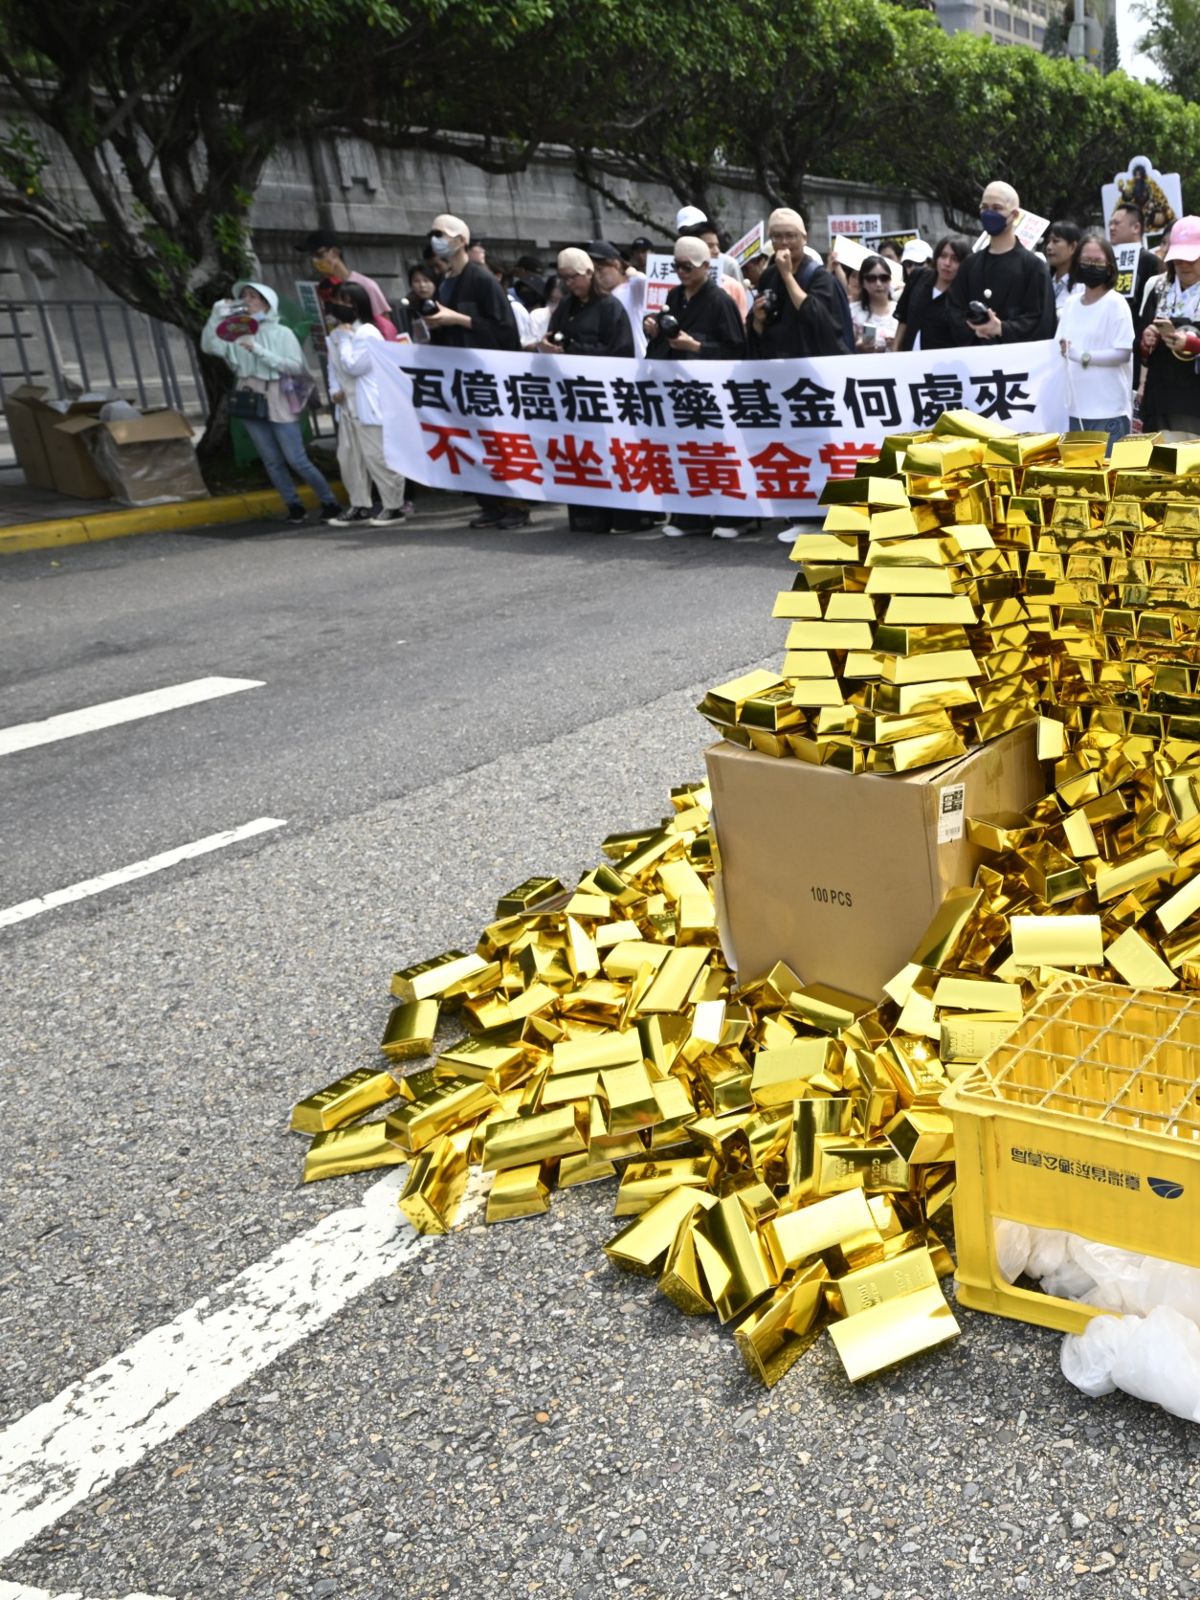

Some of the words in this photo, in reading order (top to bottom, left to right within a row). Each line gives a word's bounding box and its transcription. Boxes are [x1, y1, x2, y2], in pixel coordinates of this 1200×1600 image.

[400, 366, 1037, 430] 百億癌症新藥基金何處來
[810, 886, 828, 904] 100
[830, 888, 853, 908] PCS
